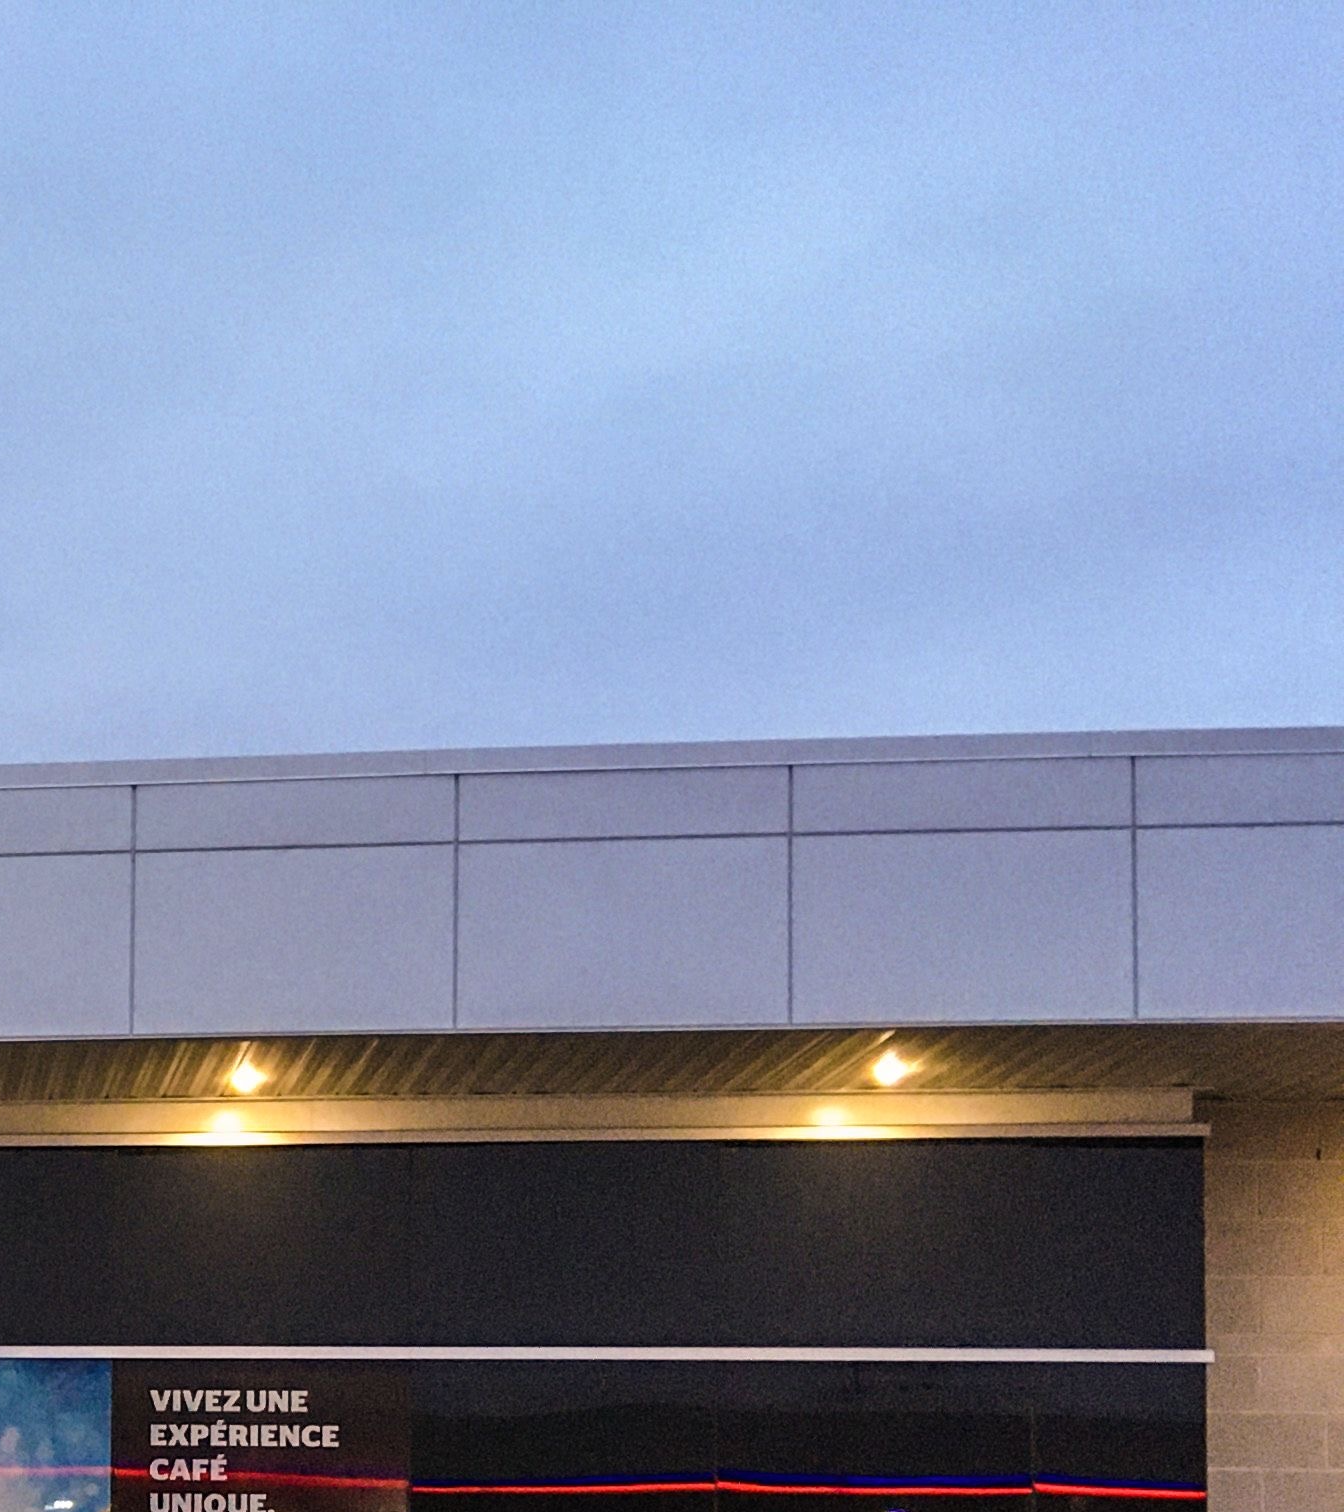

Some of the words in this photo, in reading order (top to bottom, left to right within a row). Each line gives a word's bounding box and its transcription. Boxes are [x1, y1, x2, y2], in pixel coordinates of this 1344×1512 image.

[149, 1389, 241, 1413] VIVEZ
[245, 1390, 309, 1413] UNE
[149, 1419, 340, 1448] EXPÉRIENCE
[149, 1454, 228, 1481] CAFÉ
